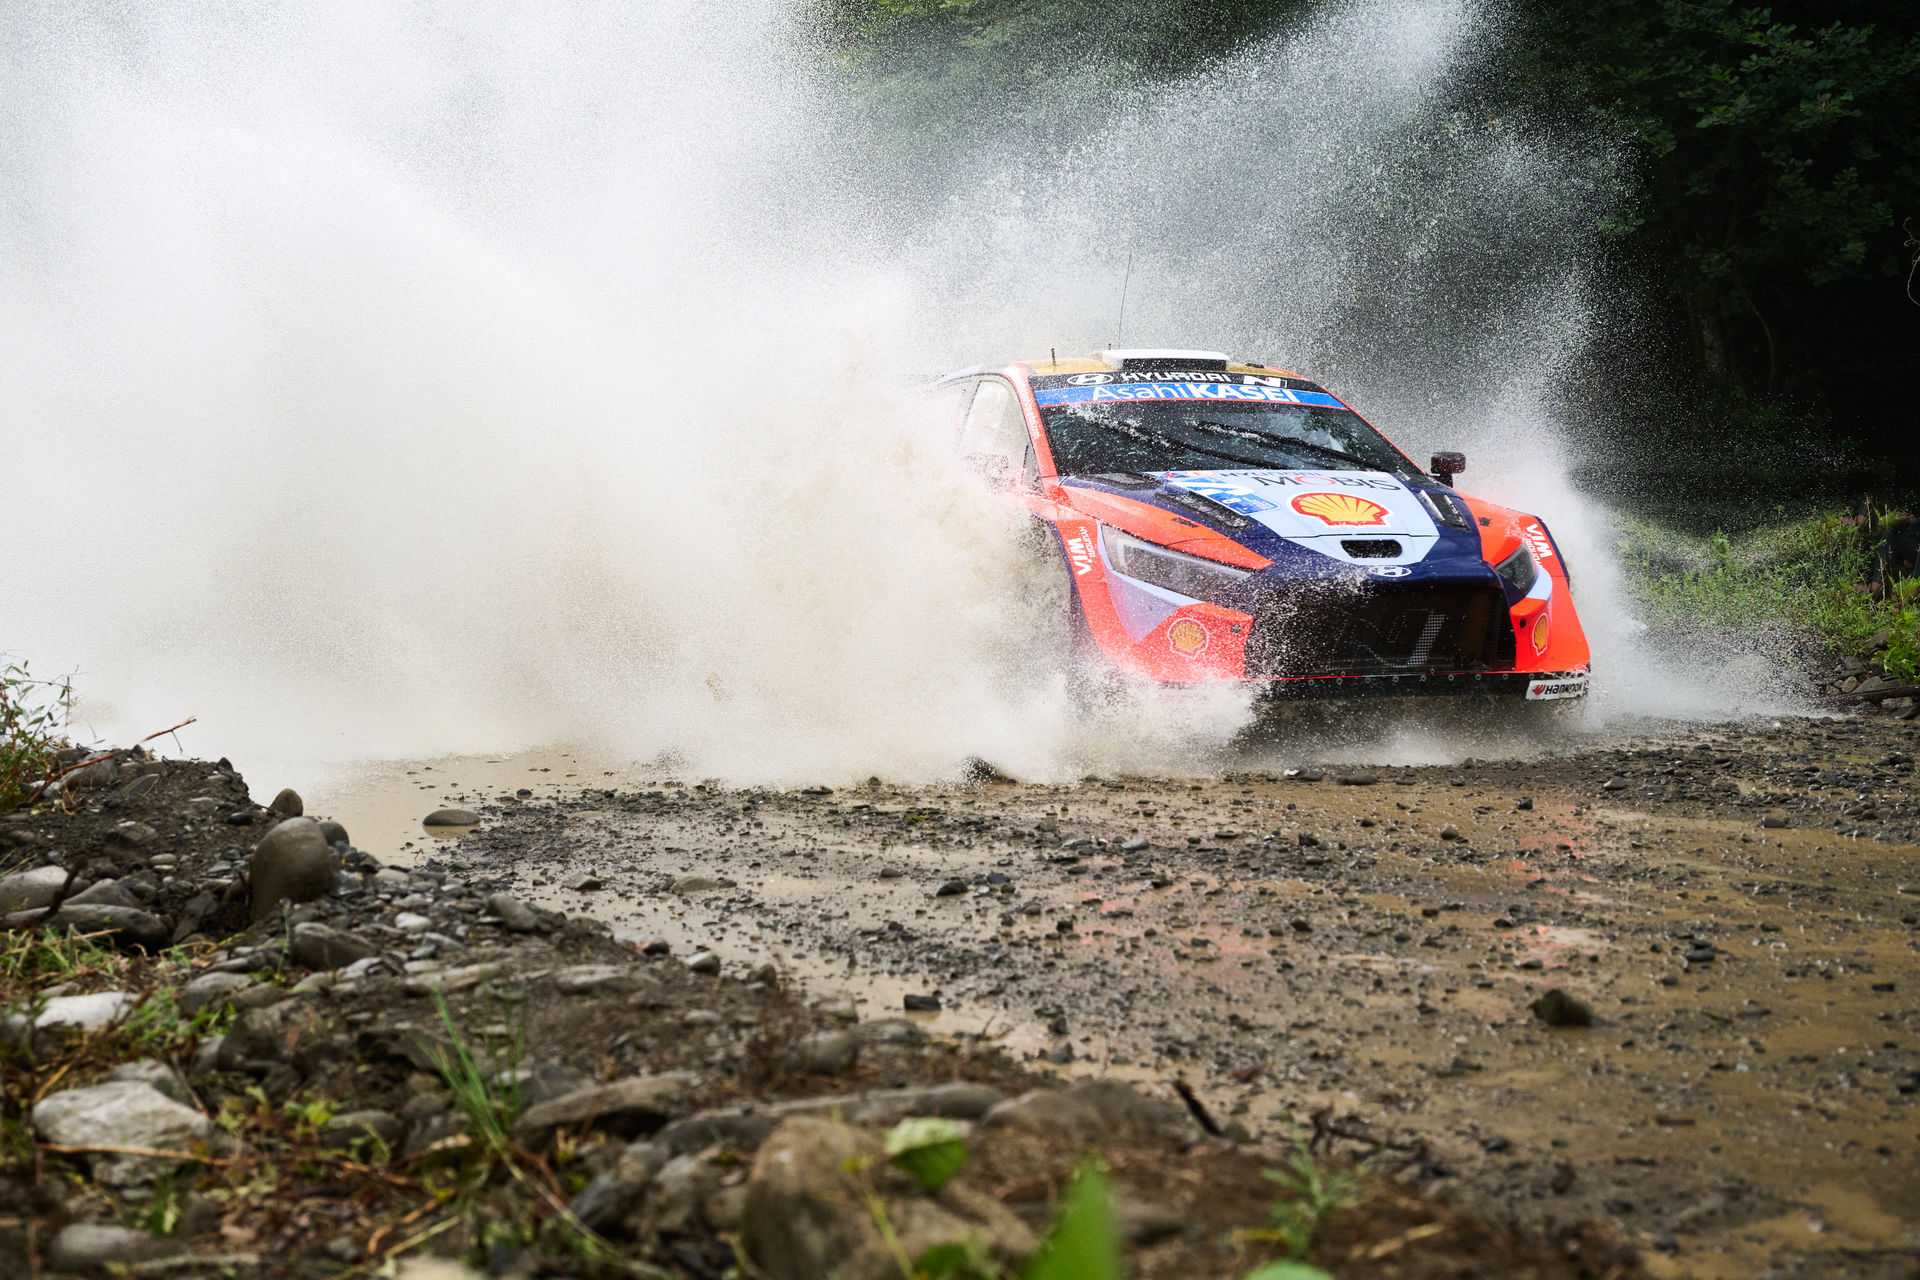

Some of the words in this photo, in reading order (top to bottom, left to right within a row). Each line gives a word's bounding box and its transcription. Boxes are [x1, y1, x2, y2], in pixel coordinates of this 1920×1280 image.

[1119, 371, 1232, 382] HYUNDAI
[1252, 476, 1401, 491] MOBIS
[1079, 526, 1096, 558] HYUNDAI
